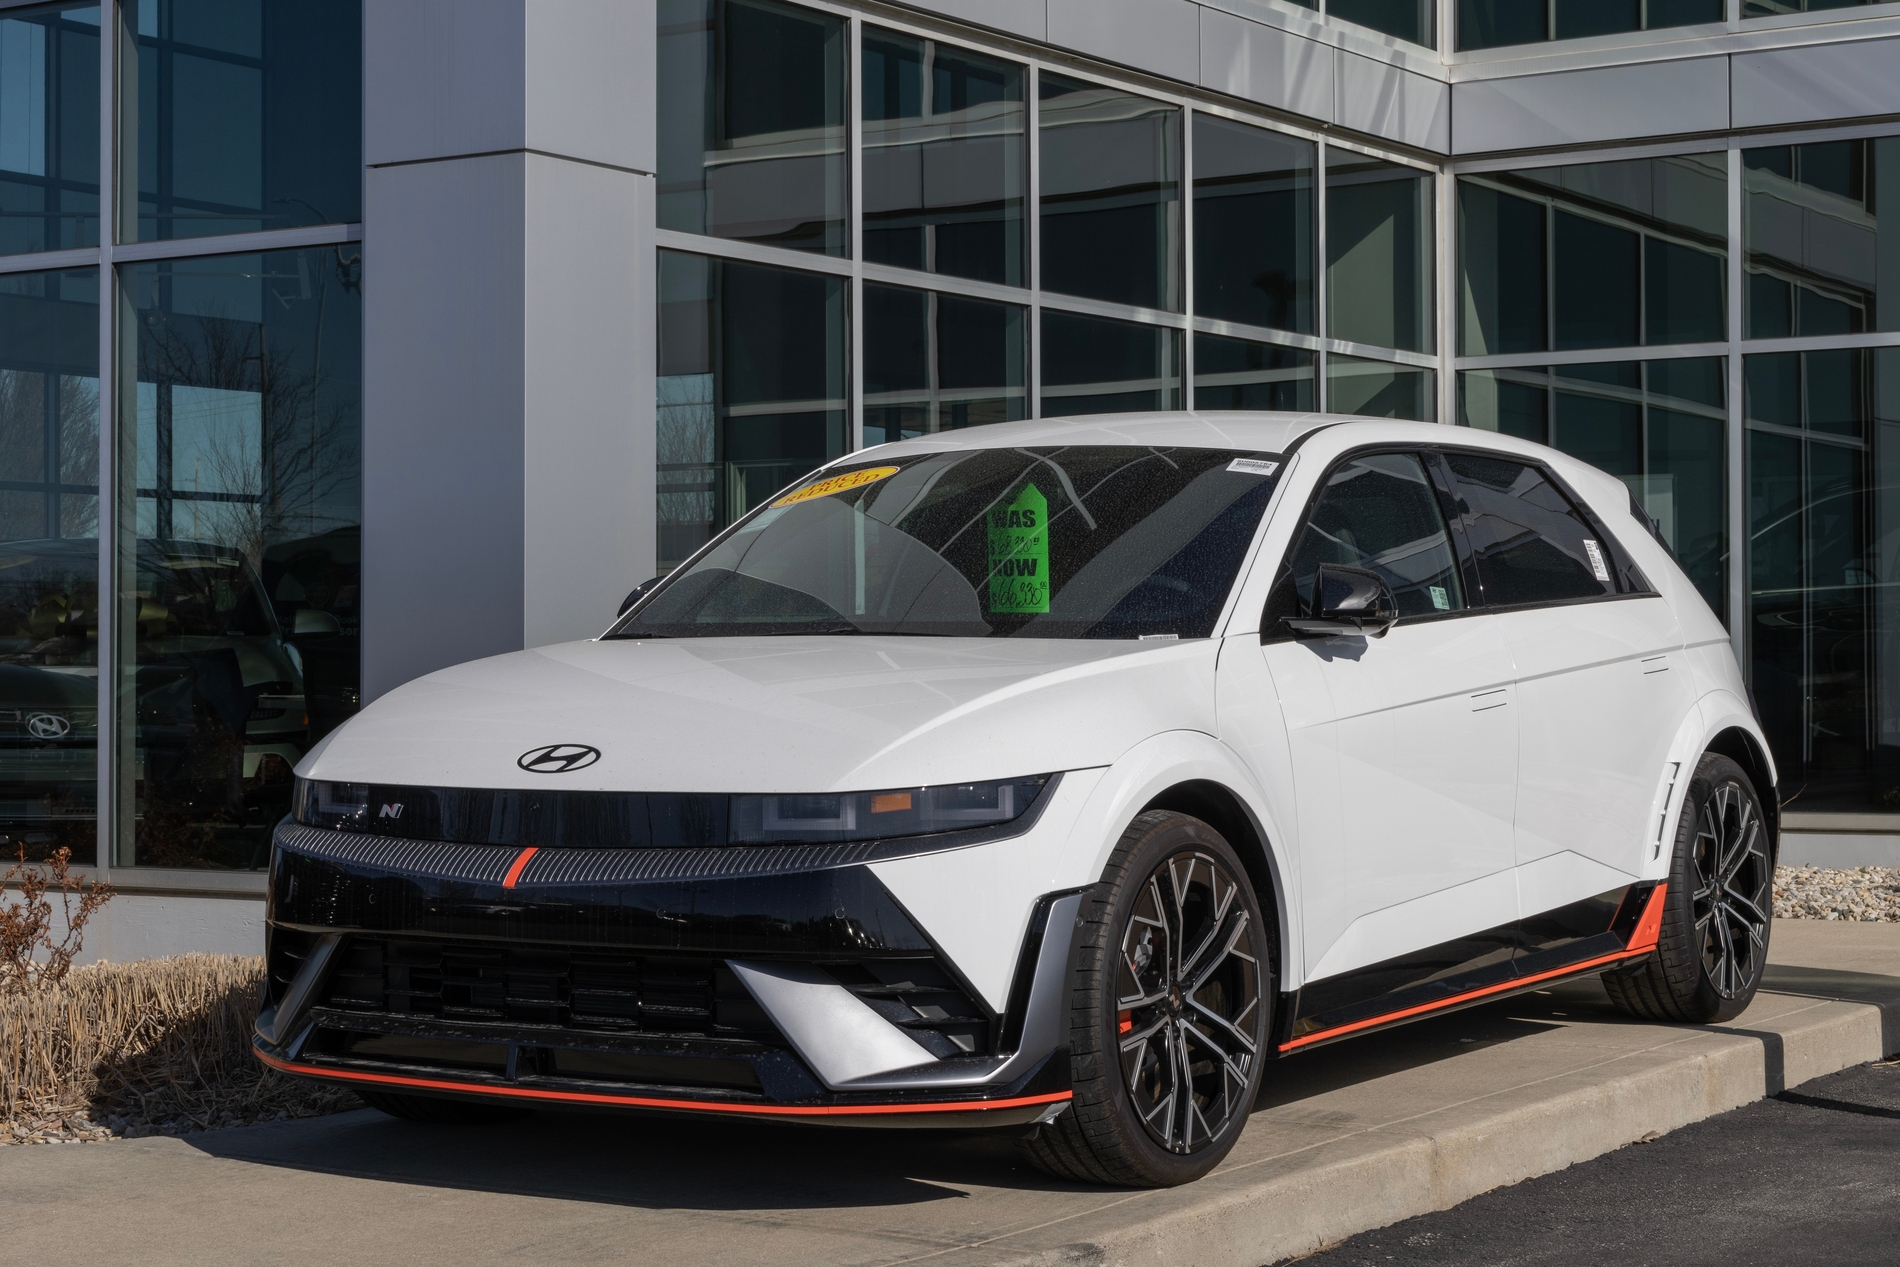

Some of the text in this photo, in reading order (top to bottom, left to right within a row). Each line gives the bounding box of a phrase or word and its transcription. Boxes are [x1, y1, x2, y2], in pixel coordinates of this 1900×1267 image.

[783, 473, 880, 504] REDUCED
[809, 470, 869, 490] PRICE
[991, 508, 1037, 528] WAS
[991, 558, 1038, 577] NOW
